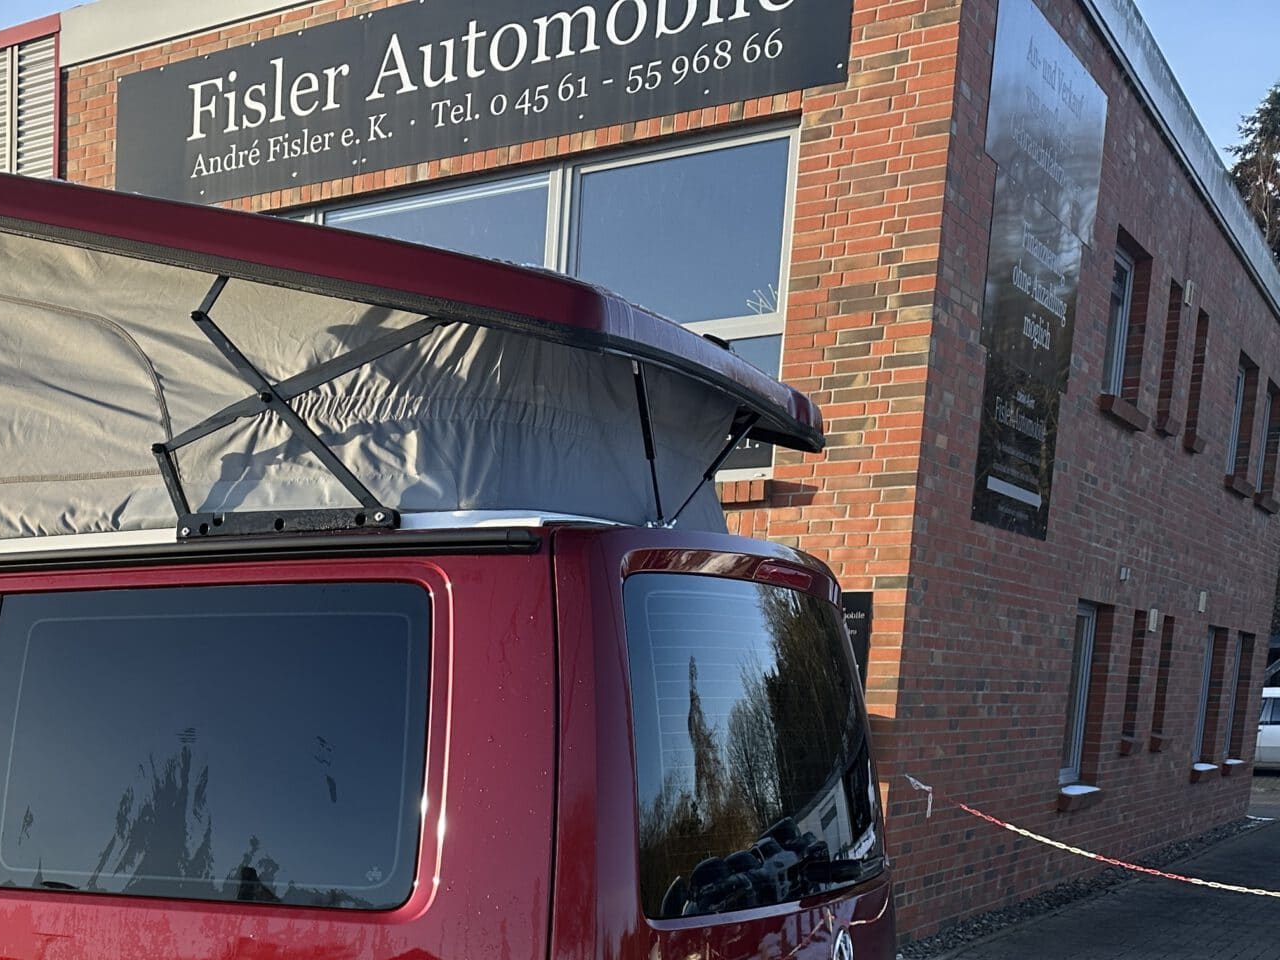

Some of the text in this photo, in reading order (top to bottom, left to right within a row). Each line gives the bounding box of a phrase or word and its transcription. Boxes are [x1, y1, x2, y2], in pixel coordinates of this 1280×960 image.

[187, 0, 794, 141] Fisler Automob
[190, 140, 260, 178] André
[267, 128, 334, 162] Fisler
[341, 128, 360, 147] e.
[368, 113, 393, 141] K.
[431, 93, 480, 128] Tel.
[514, 84, 549, 116] 45
[557, 72, 588, 101] 61
[626, 60, 662, 94] 55
[672, 40, 732, 85] 968
[743, 28, 783, 63] 66
[1012, 259, 1067, 327] ohne Anzahlung
[1023, 312, 1051, 350] möglich
